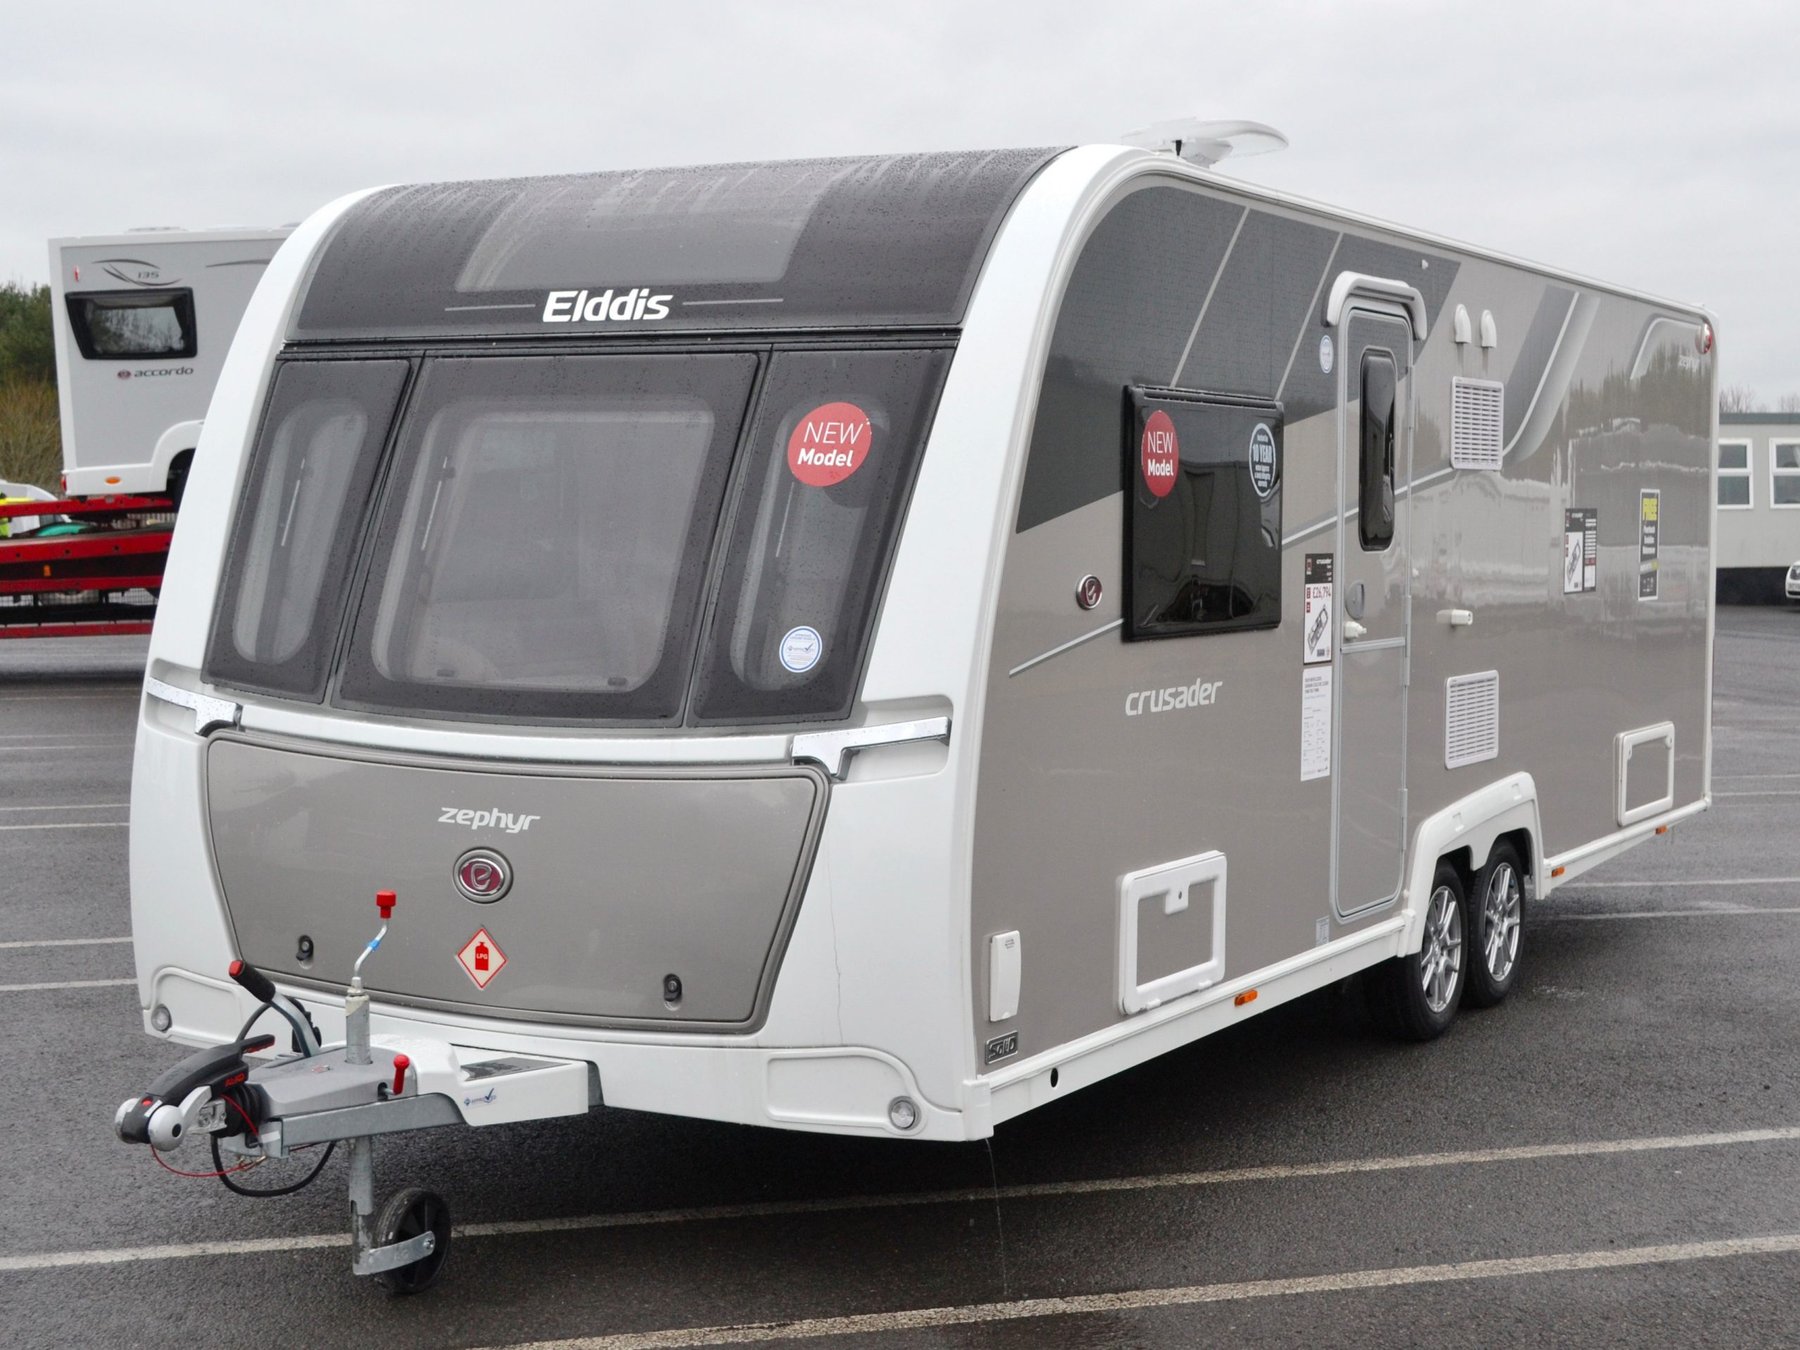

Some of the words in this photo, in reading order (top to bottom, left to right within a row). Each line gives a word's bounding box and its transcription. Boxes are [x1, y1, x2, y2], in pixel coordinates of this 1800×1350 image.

[137, 271, 160, 279] 135
[542, 288, 673, 322] Elddis
[134, 366, 194, 378] accordo
[803, 421, 863, 445] NEW
[1147, 431, 1174, 454] NEW
[797, 447, 854, 467] Model
[1252, 443, 1259, 463] 10
[1147, 458, 1174, 476] Model
[1125, 678, 1223, 716] crusader
[438, 807, 541, 833] zephyr
